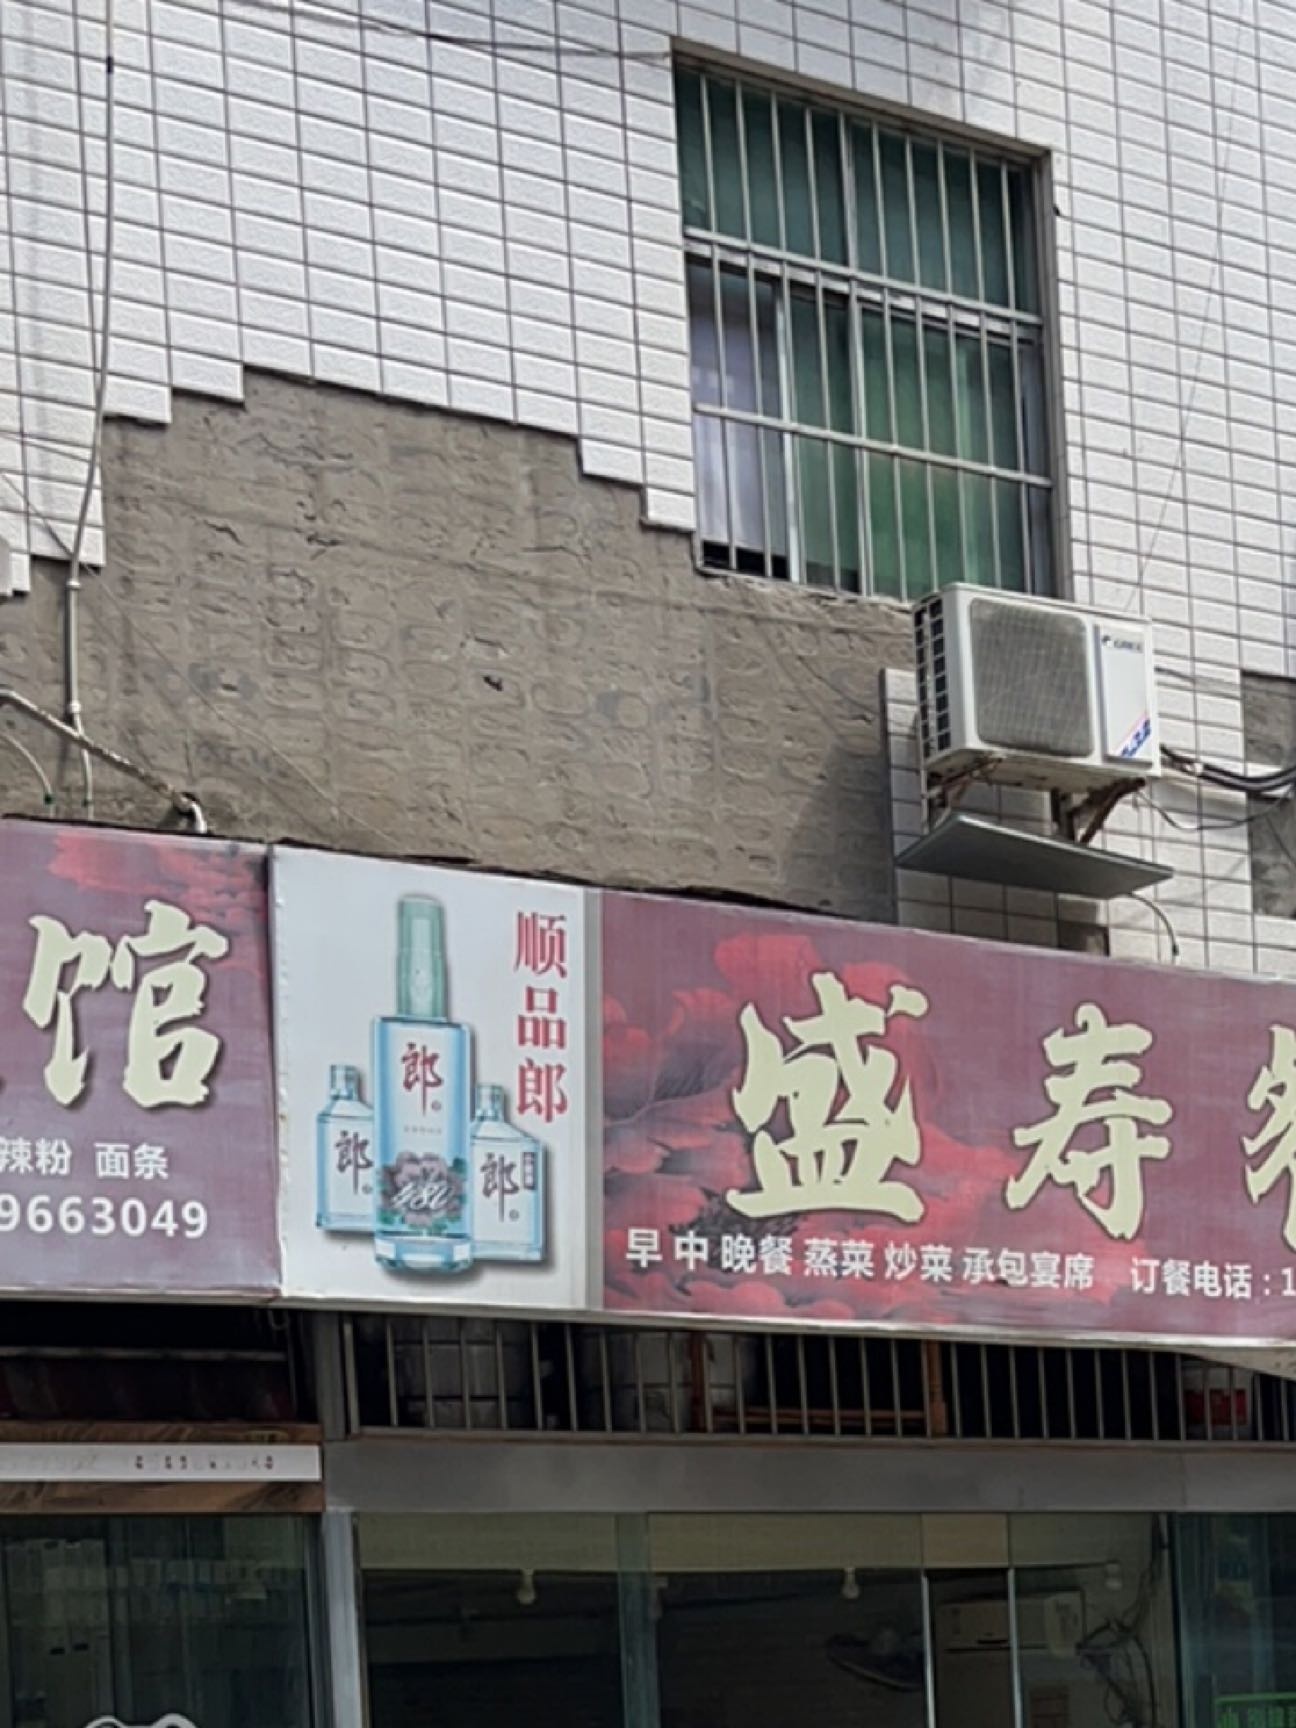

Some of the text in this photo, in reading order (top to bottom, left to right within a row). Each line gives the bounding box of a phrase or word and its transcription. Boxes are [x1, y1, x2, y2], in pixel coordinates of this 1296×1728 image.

[23, 900, 229, 1108] 馆
[514, 910, 569, 1124] 顺品郎
[93, 1142, 169, 1180] 面条
[0, 1192, 208, 1239] 9663049
[625, 1227, 664, 1269] 早
[674, 1230, 709, 1272] 中
[720, 1232, 793, 1276] 晚餐
[804, 1237, 875, 1279] 蒸菜
[884, 1239, 953, 1283] 炒菜
[962, 1246, 1096, 1292] 承包宴席
